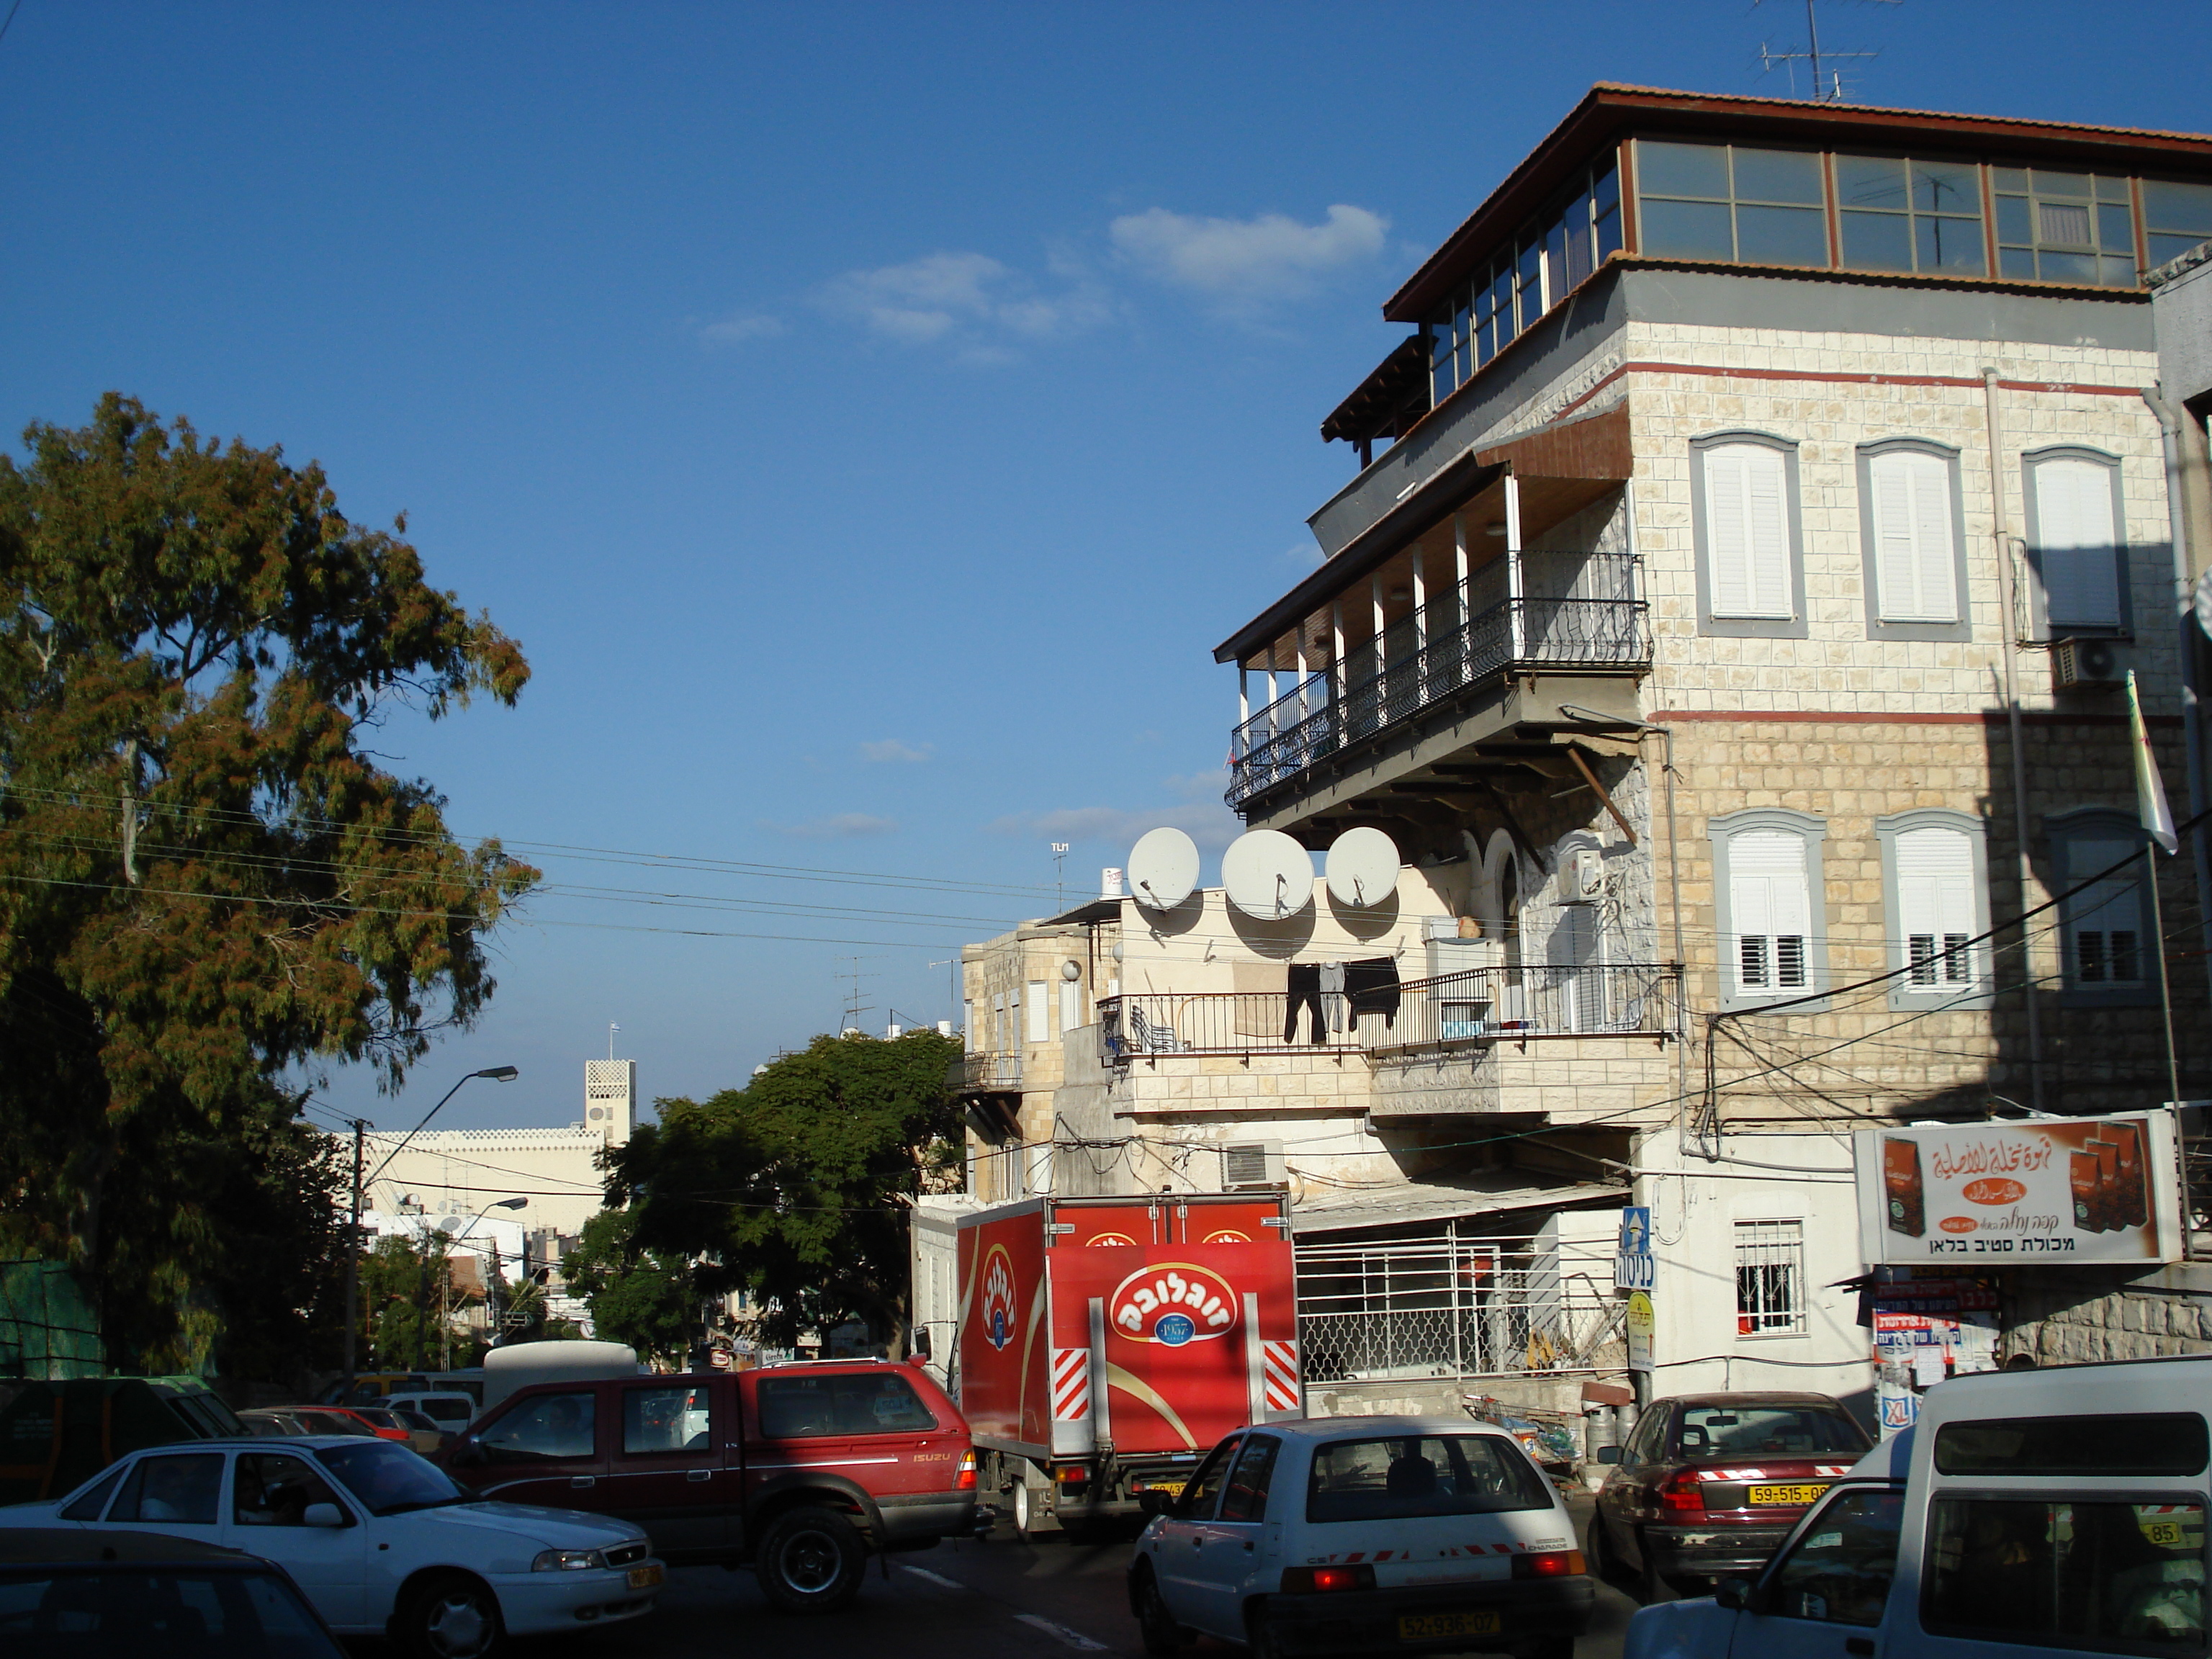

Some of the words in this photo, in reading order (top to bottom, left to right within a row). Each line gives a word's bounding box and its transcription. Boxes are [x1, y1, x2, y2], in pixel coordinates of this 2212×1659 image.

[2032, 1215, 2059, 1236] קפה
[1929, 1238, 1968, 1254] בלאן
[1974, 1239, 2014, 1252] סטיב
[2021, 1238, 2074, 1251] מכולת
[1619, 1251, 1654, 1287] כניסה
[1118, 1272, 1230, 1332] זוגלובק
[1886, 1401, 1908, 1424] XL
[913, 1453, 950, 1462] ISUZU
[1404, 1613, 1493, 1635] 52-936-07
